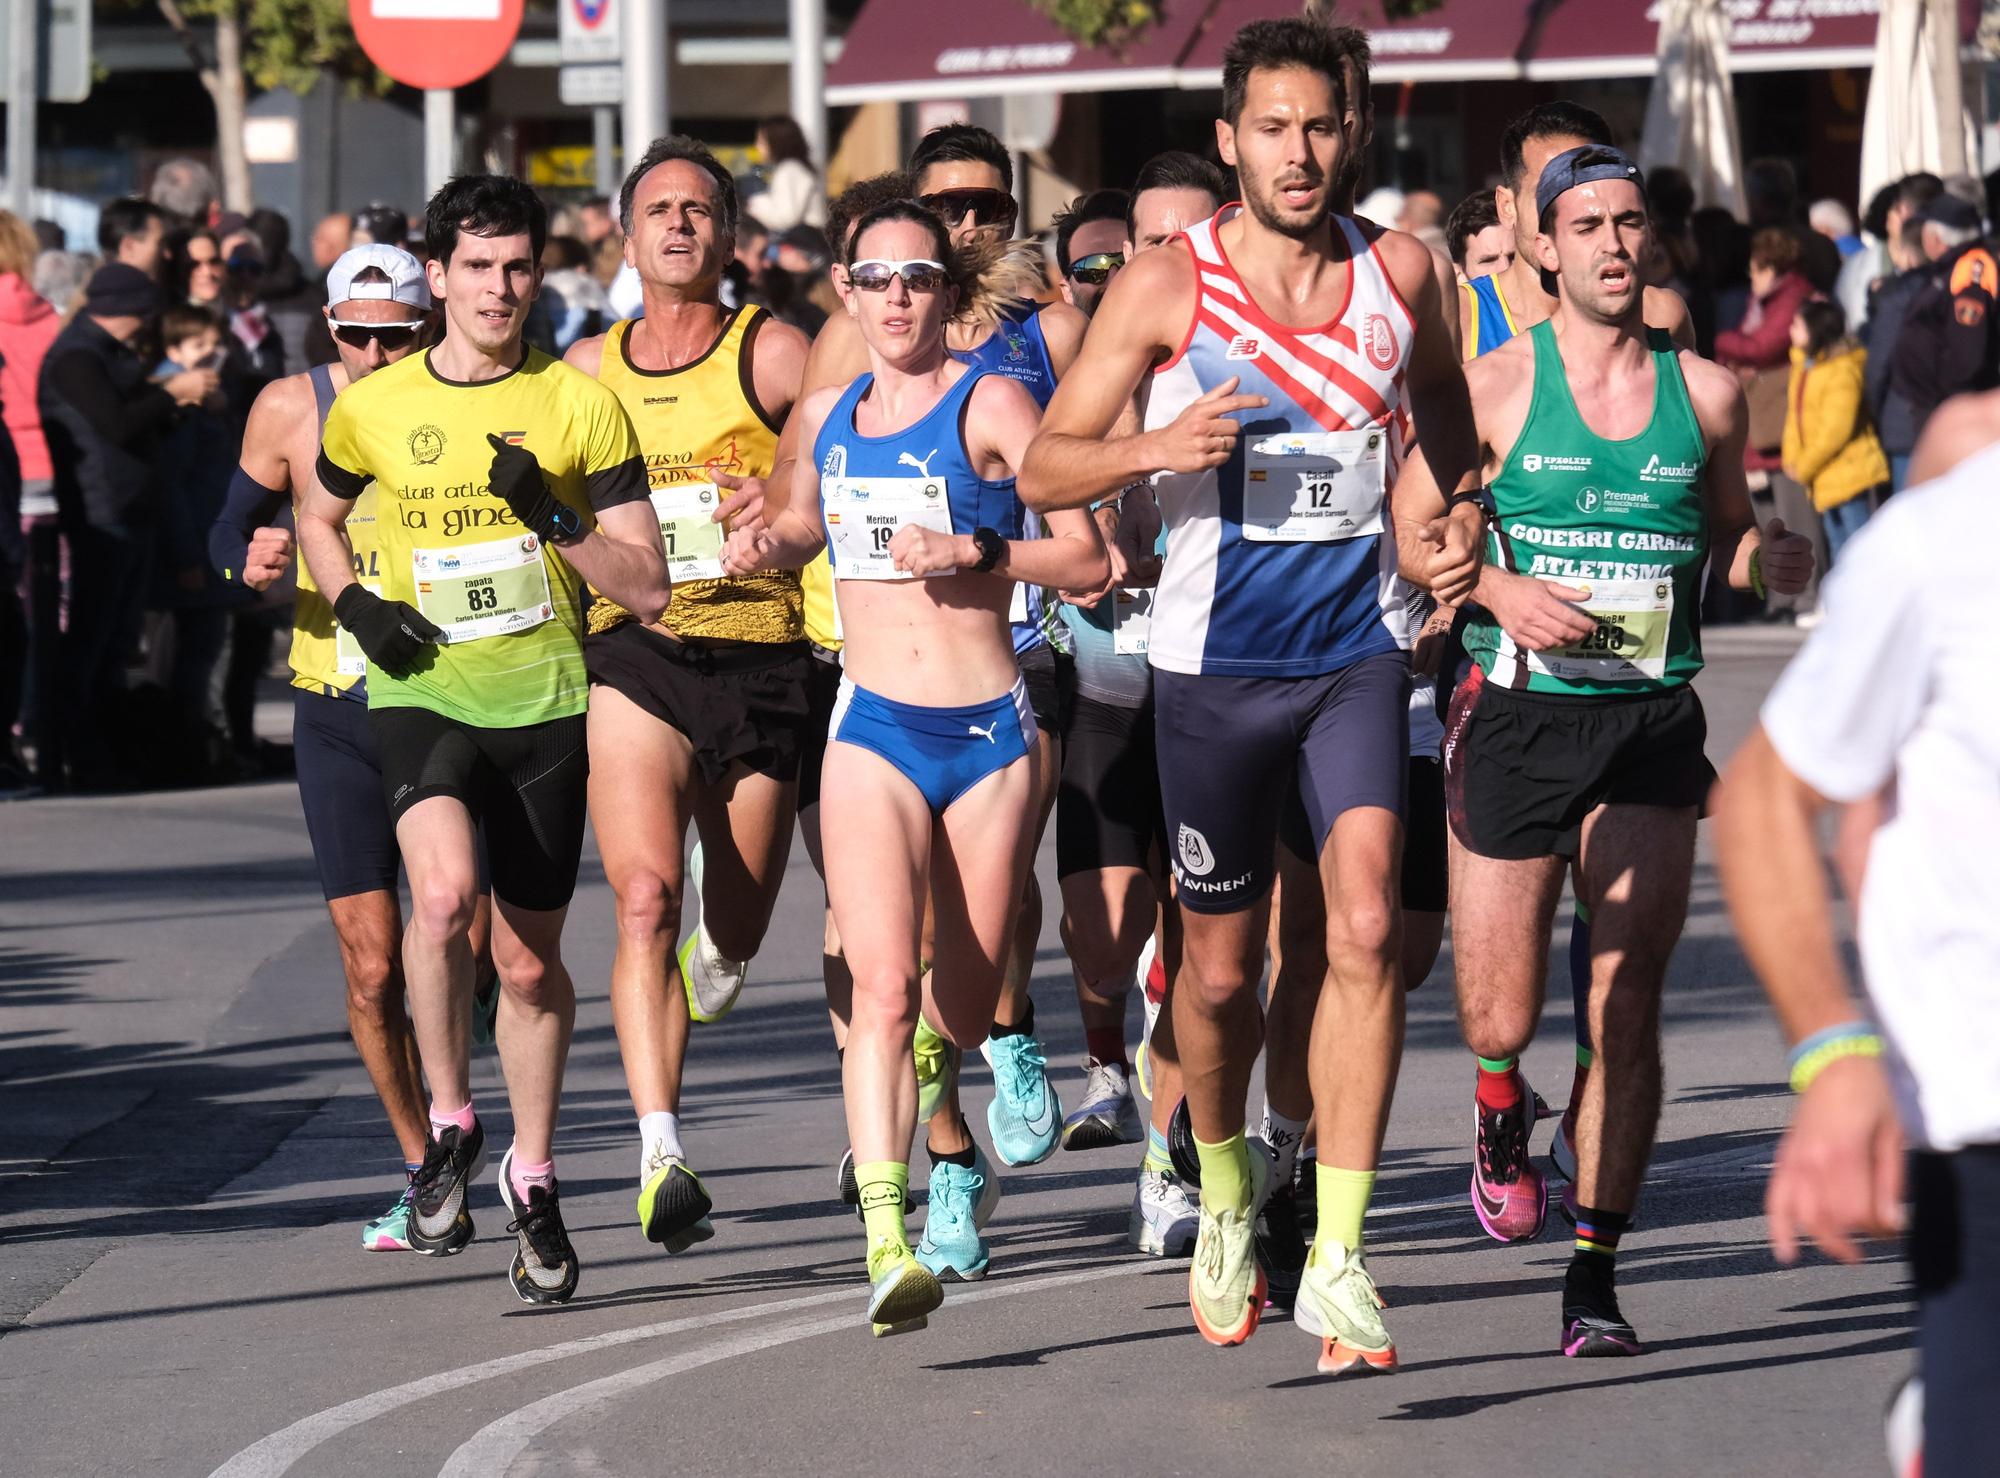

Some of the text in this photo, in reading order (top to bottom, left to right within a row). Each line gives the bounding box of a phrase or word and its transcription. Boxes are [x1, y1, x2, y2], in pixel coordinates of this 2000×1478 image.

[444, 482, 489, 499] atle
[648, 470, 691, 486] DADA
[1307, 482, 1333, 508] 12
[1603, 489, 1650, 503] Premank
[398, 502, 519, 537] la gine
[866, 515, 898, 525] Meritxel
[1509, 523, 1614, 549] GOIERRI
[1527, 555, 1674, 581] ATLETISMO
[464, 576, 494, 589] zapata
[467, 586, 498, 612] 83
[455, 614, 474, 623] Carlos
[1580, 625, 1625, 651] 293
[1184, 869, 1254, 894] AVINENT
